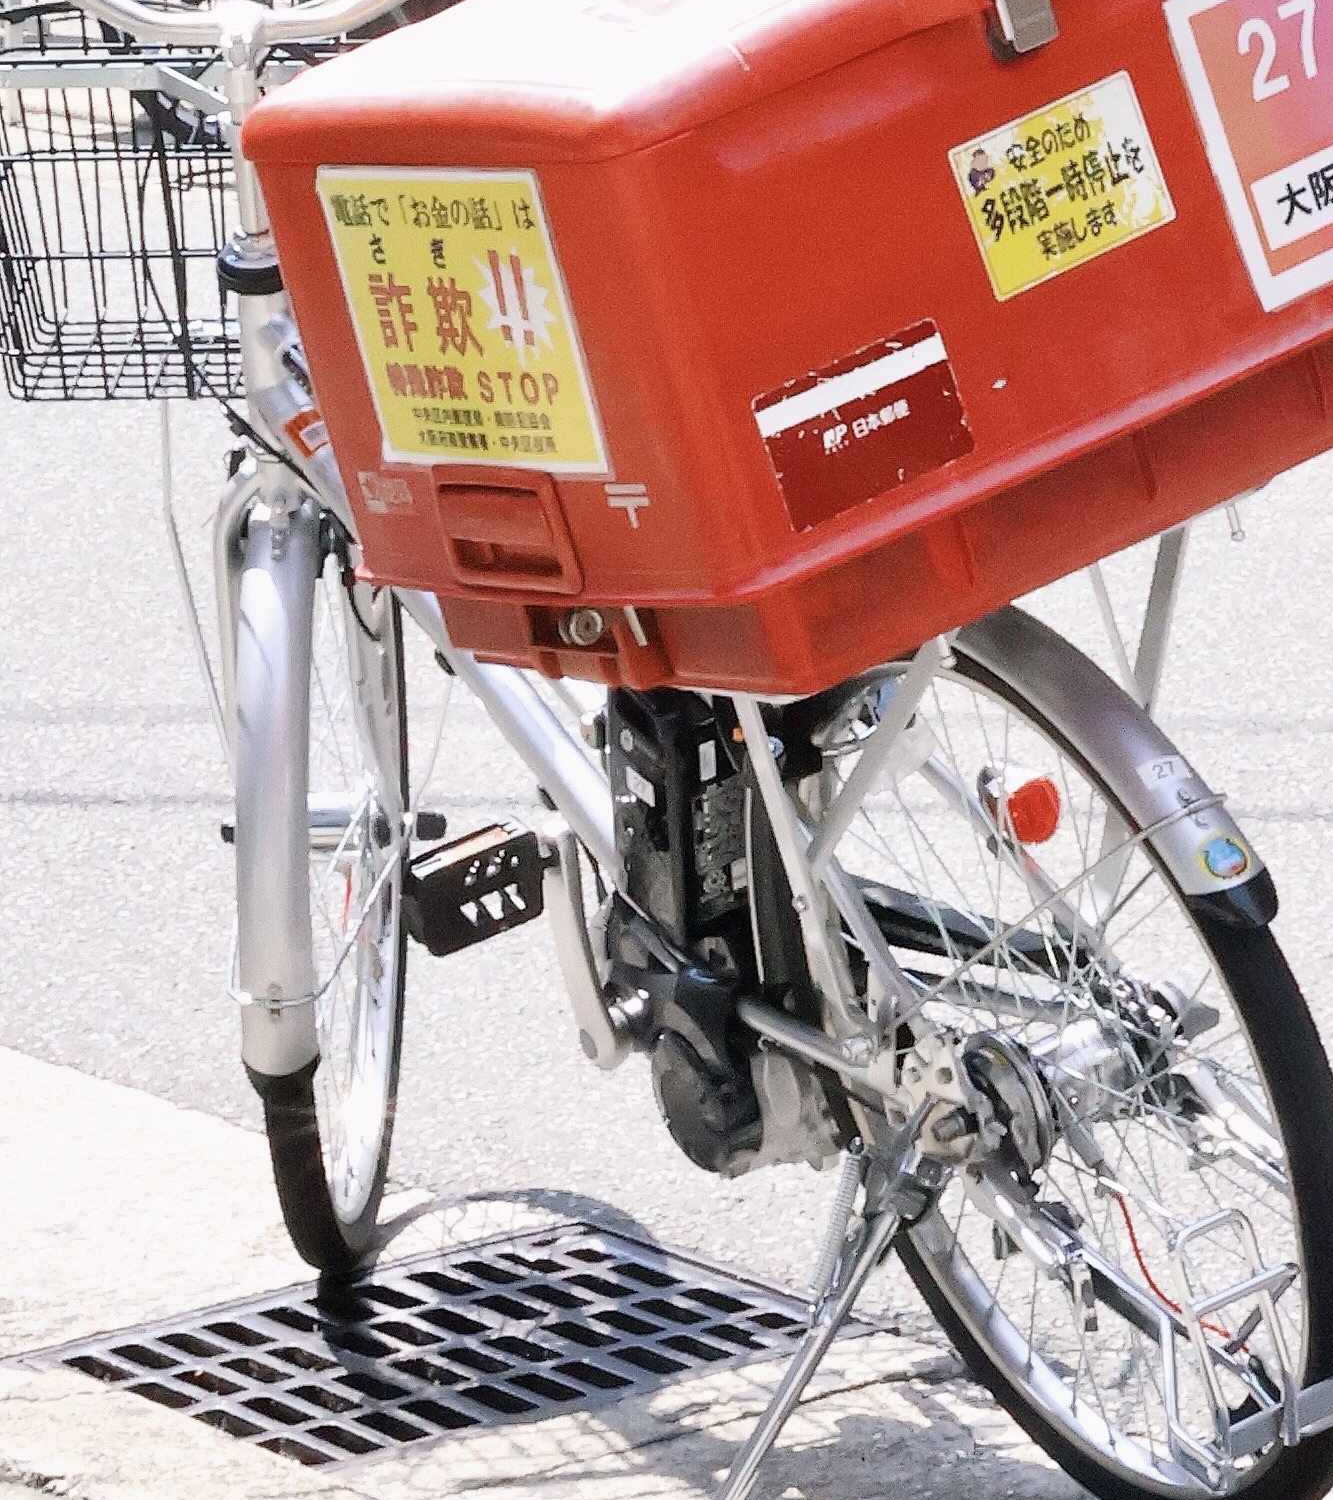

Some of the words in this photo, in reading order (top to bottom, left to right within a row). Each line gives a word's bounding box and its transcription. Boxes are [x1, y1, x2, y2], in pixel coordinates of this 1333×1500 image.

[1005, 111, 1091, 172] 安全のため
[981, 137, 1145, 242] 多段階一時停止を
[1036, 200, 1118, 261] 実施します
[477, 370, 559, 405] STOP
[1152, 760, 1175, 780] 27
